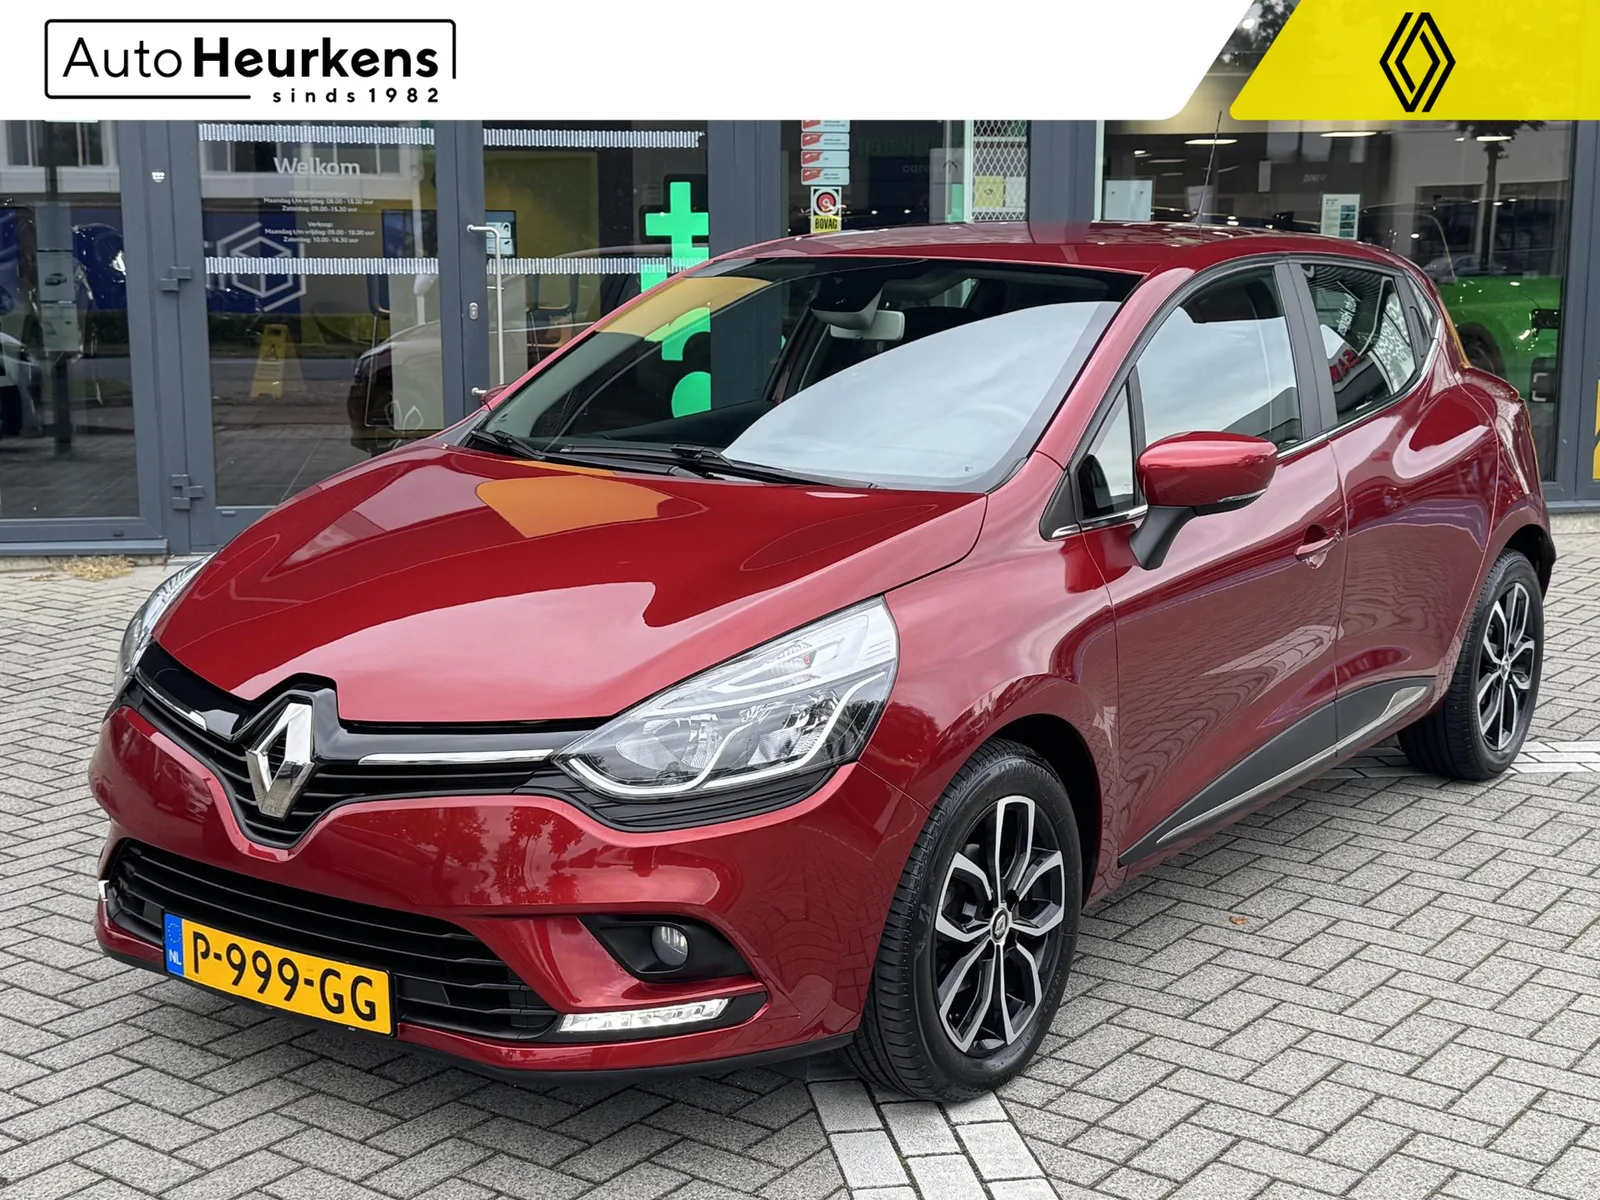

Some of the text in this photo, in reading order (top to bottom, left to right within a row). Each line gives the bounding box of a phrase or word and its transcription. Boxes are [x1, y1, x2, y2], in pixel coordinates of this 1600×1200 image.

[273, 157, 360, 176] Welkom
[263, 197, 291, 205] Maandag
[814, 218, 838, 230] BOVAG
[168, 949, 182, 966] NL
[192, 930, 377, 1022] P-999-GG
